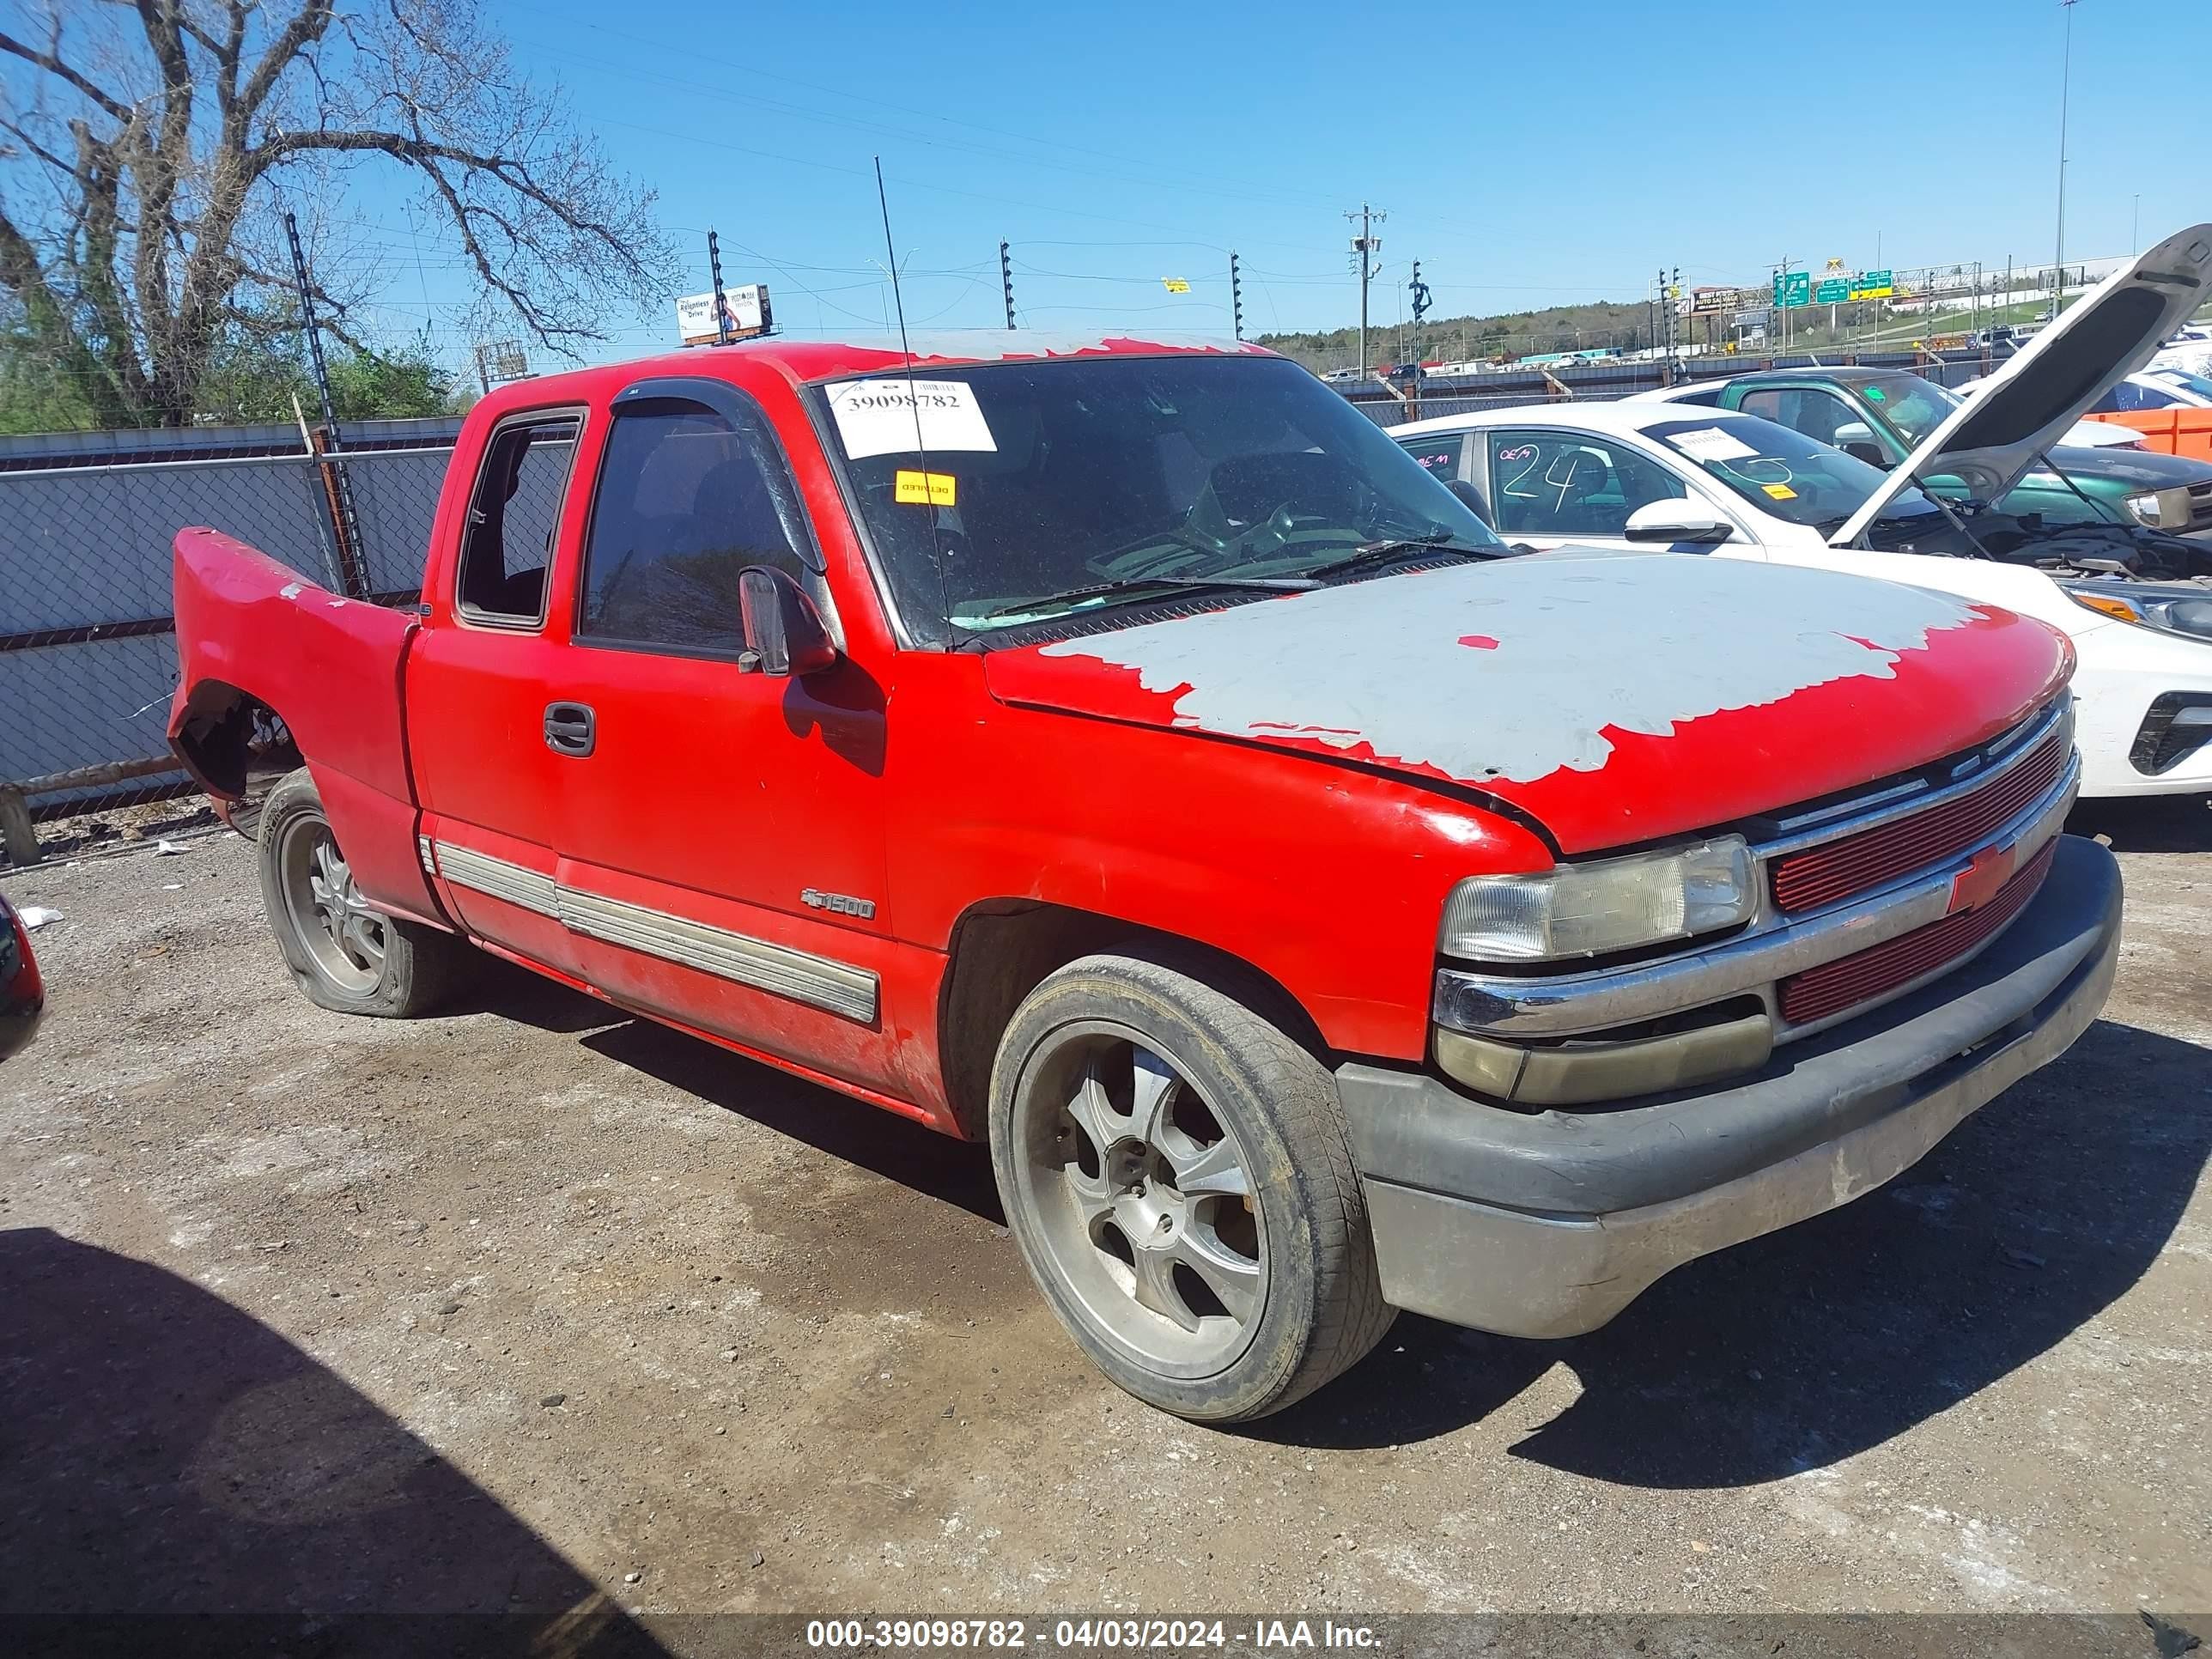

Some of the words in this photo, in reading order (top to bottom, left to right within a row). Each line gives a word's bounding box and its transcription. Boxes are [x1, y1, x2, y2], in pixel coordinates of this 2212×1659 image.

[680, 300, 709, 311] Relentless
[847, 395, 960, 411] 39098782
[1504, 444, 1578, 514] 24
[824, 893, 876, 919] 1500
